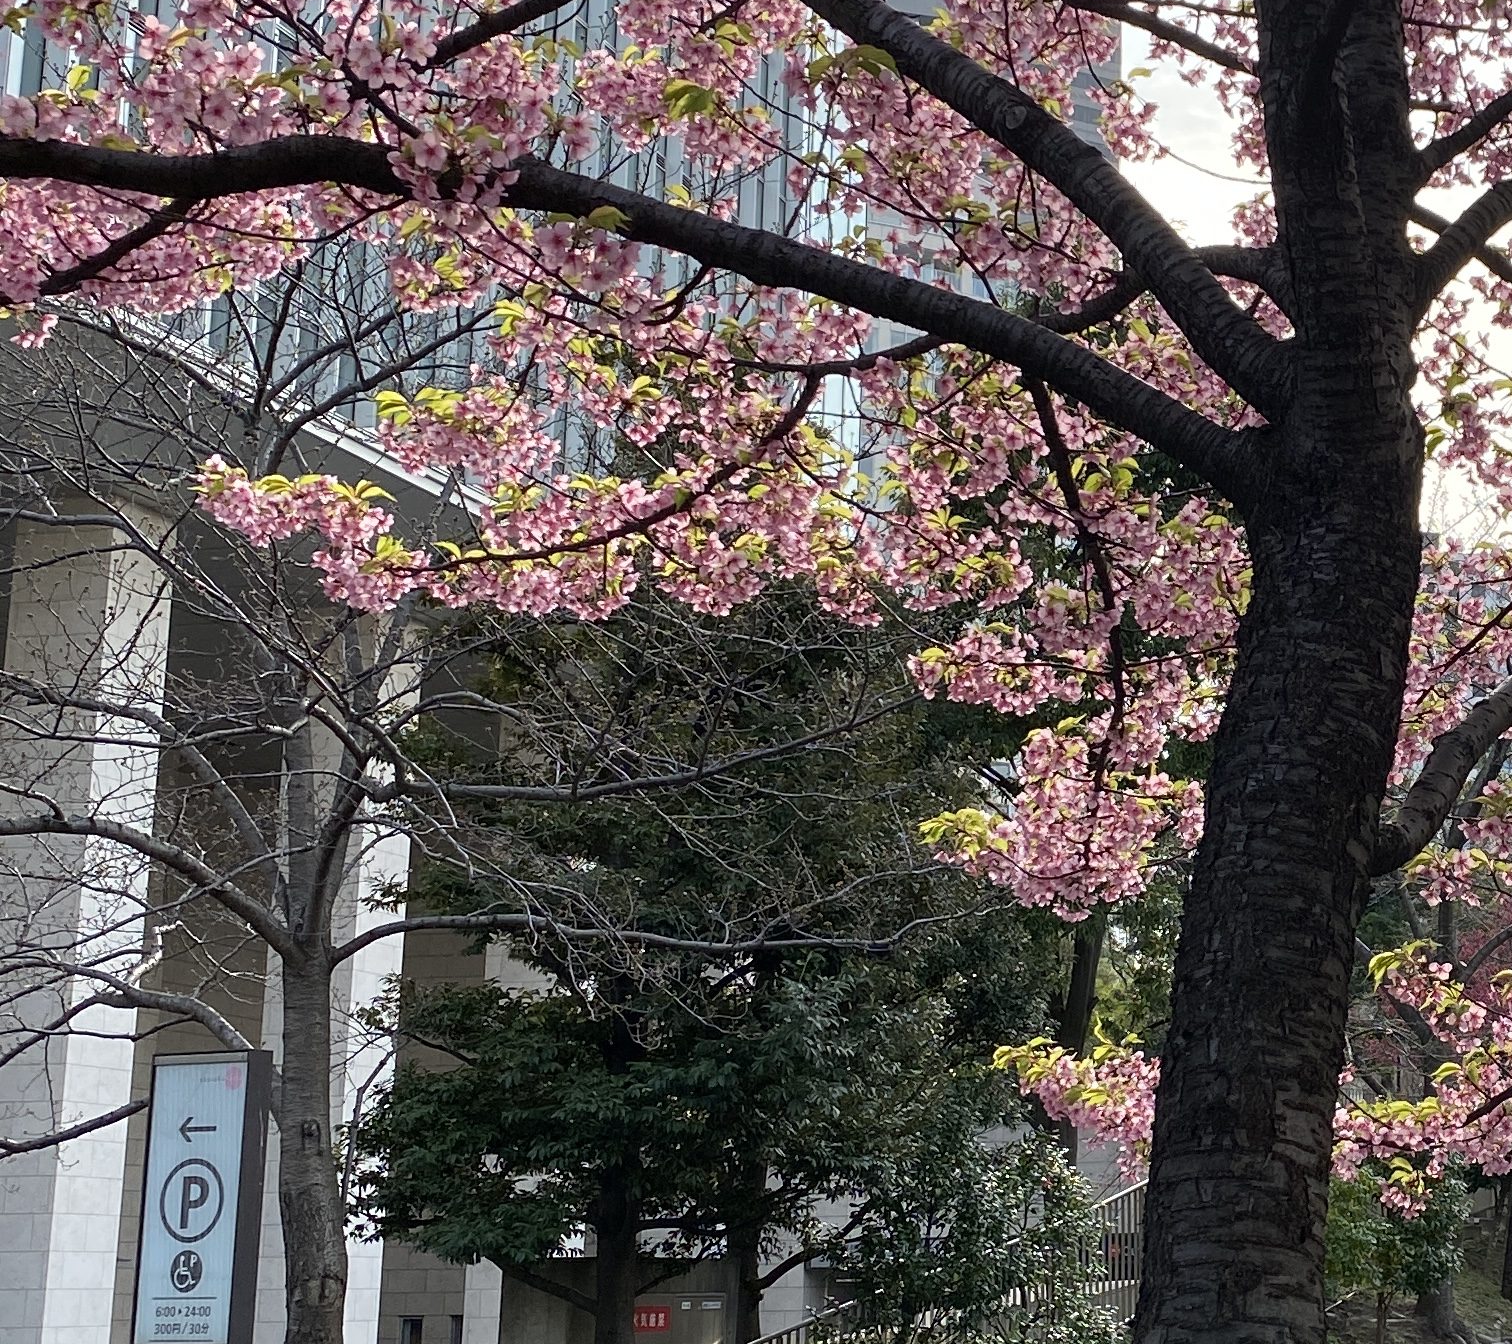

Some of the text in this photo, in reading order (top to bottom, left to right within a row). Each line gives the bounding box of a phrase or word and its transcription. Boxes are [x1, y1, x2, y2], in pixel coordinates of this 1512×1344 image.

[179, 1175, 210, 1230] P
[155, 1305, 211, 1317] 6:00 24:00
[153, 1322, 209, 1335] 300円/30分
